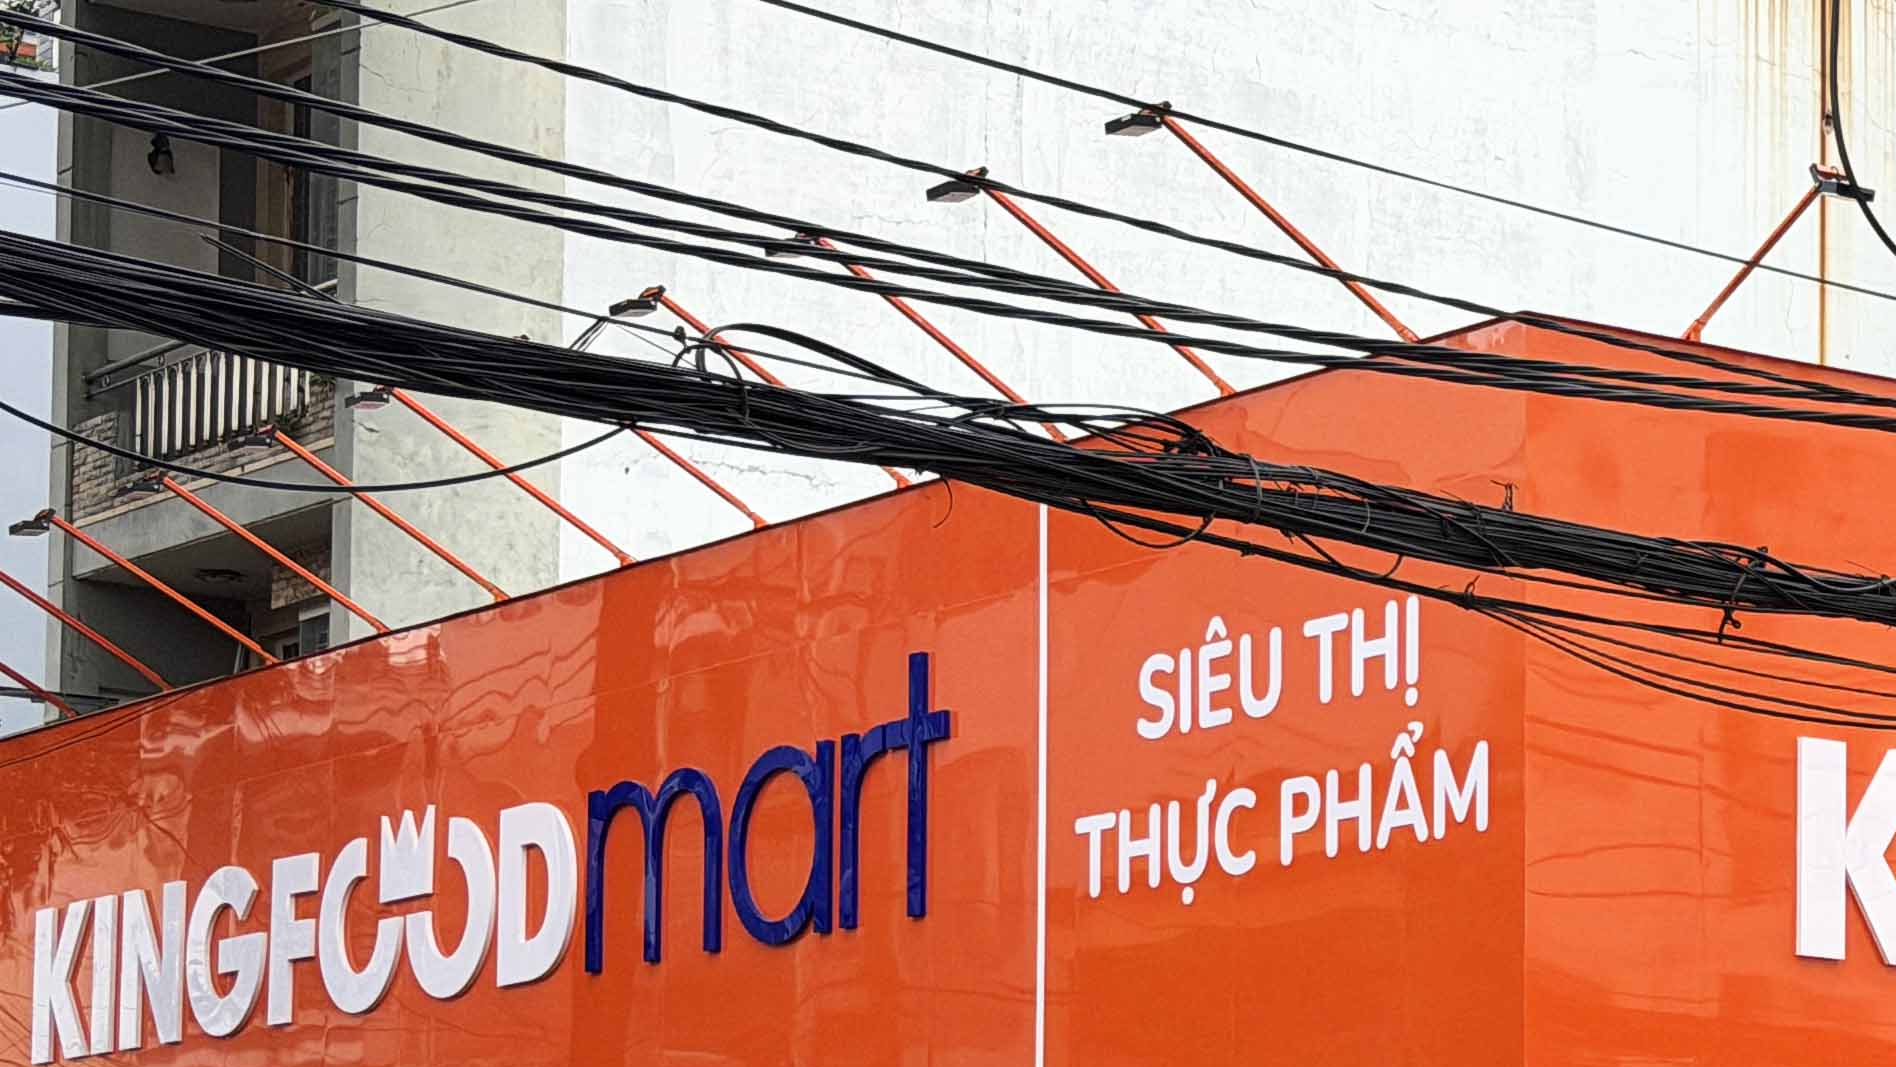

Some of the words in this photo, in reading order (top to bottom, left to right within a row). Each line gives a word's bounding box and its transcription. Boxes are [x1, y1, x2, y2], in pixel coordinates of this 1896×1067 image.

[1137, 616, 1282, 740] SIÊU
[1304, 595, 1420, 706] THỊ
[30, 652, 950, 1066] KINGFOODmart
[1075, 778, 1257, 905] THỰC
[1280, 721, 1489, 866] PHẨM
